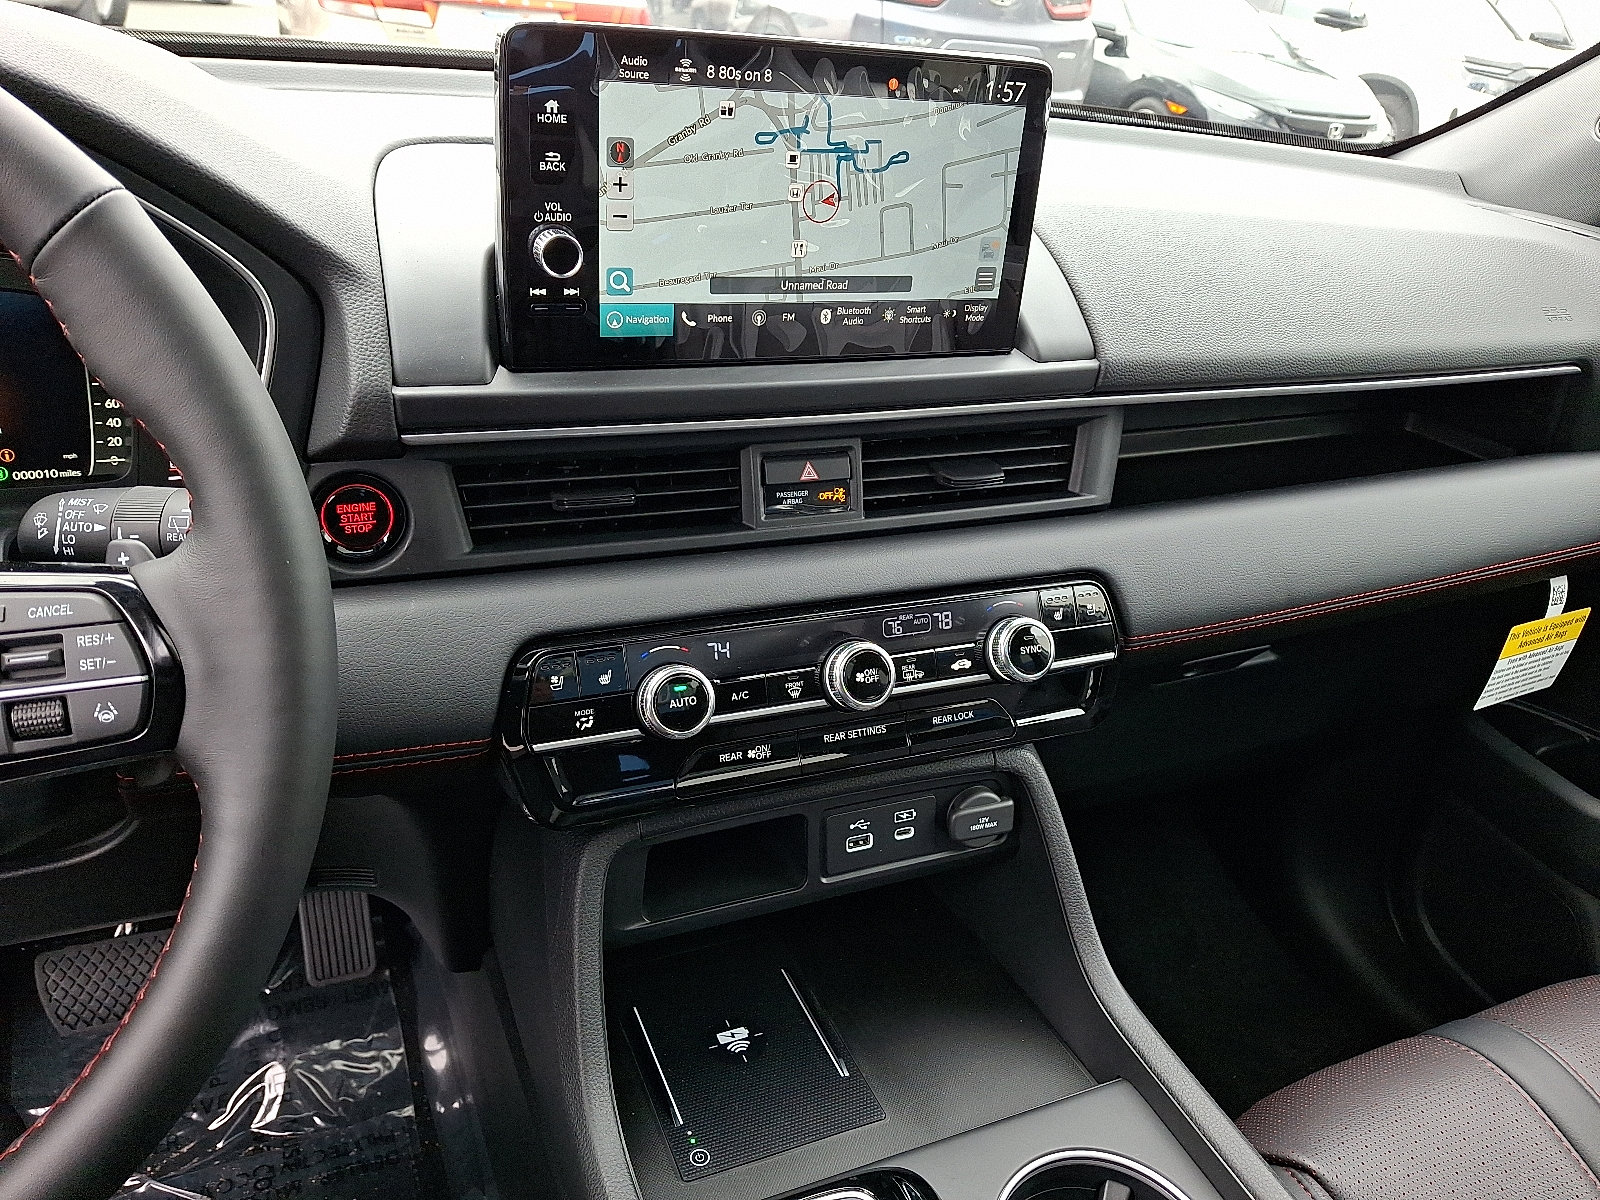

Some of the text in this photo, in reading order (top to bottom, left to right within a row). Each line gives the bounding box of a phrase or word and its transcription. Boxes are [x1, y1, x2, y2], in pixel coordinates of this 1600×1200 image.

[621, 55, 648, 67] Audio
[619, 69, 650, 80] Source
[707, 65, 772, 82] 8 80s on 8
[987, 80, 1027, 103] 1:57
[537, 113, 567, 124] HOME
[667, 114, 711, 147] Granby Rd
[616, 142, 625, 153] N
[701, 151, 731, 163] Granby
[732, 149, 744, 159] Rd
[539, 162, 566, 172] BACK
[544, 202, 563, 211] VOL
[739, 202, 753, 212] Ter
[545, 212, 572, 222] AUDIO
[828, 262, 839, 271] Dr
[658, 273, 702, 287] Beauregard
[780, 279, 848, 291] Unnamed Road
[837, 306, 872, 316] Bluetooth
[906, 305, 926, 315] Smart
[964, 304, 989, 313] Display
[626, 314, 670, 326] Navigation
[707, 313, 733, 323] Phone
[782, 312, 795, 322] FM
[842, 316, 864, 326] Audio
[899, 315, 931, 324] Shortcuts
[965, 314, 985, 322] Mode
[104, 399, 120, 409] 60
[105, 418, 122, 428] 40
[107, 437, 123, 447] 20
[63, 452, 78, 460] mph
[12, 469, 82, 480] 000010 miles
[776, 490, 809, 498] PASSENGER
[819, 491, 833, 500] OFF
[68, 498, 94, 506] MIST
[336, 502, 376, 513] ENGINE
[64, 510, 85, 519] OFF
[340, 512, 374, 523] START
[62, 522, 92, 532] AUTO
[344, 524, 372, 534] STOP
[61, 534, 75, 544] LO
[63, 546, 74, 556] HI
[28, 603, 73, 619] CANCEL
[933, 611, 953, 629] 78
[887, 617, 929, 634] 76 AUTO
[1508, 632, 1522, 642] This
[1522, 625, 1543, 638] Vehicle
[1548, 617, 1574, 632] Equipped
[1517, 630, 1568, 649] Advanced Air Bags
[707, 641, 730, 660] 74
[1020, 645, 1042, 655] SYNC
[864, 668, 879, 677] ON/
[865, 675, 880, 683] OFF
[731, 691, 750, 701] A/C
[669, 696, 697, 709] AUTO
[574, 708, 595, 717] MODE
[932, 710, 975, 725] REAR LOCK
[823, 725, 887, 743] REAR SETTINGS
[755, 744, 771, 752] ON/
[719, 751, 743, 763] REAR
[756, 751, 772, 760] OFF
[978, 816, 990, 824] 12V
[985, 821, 998, 830] MAX
